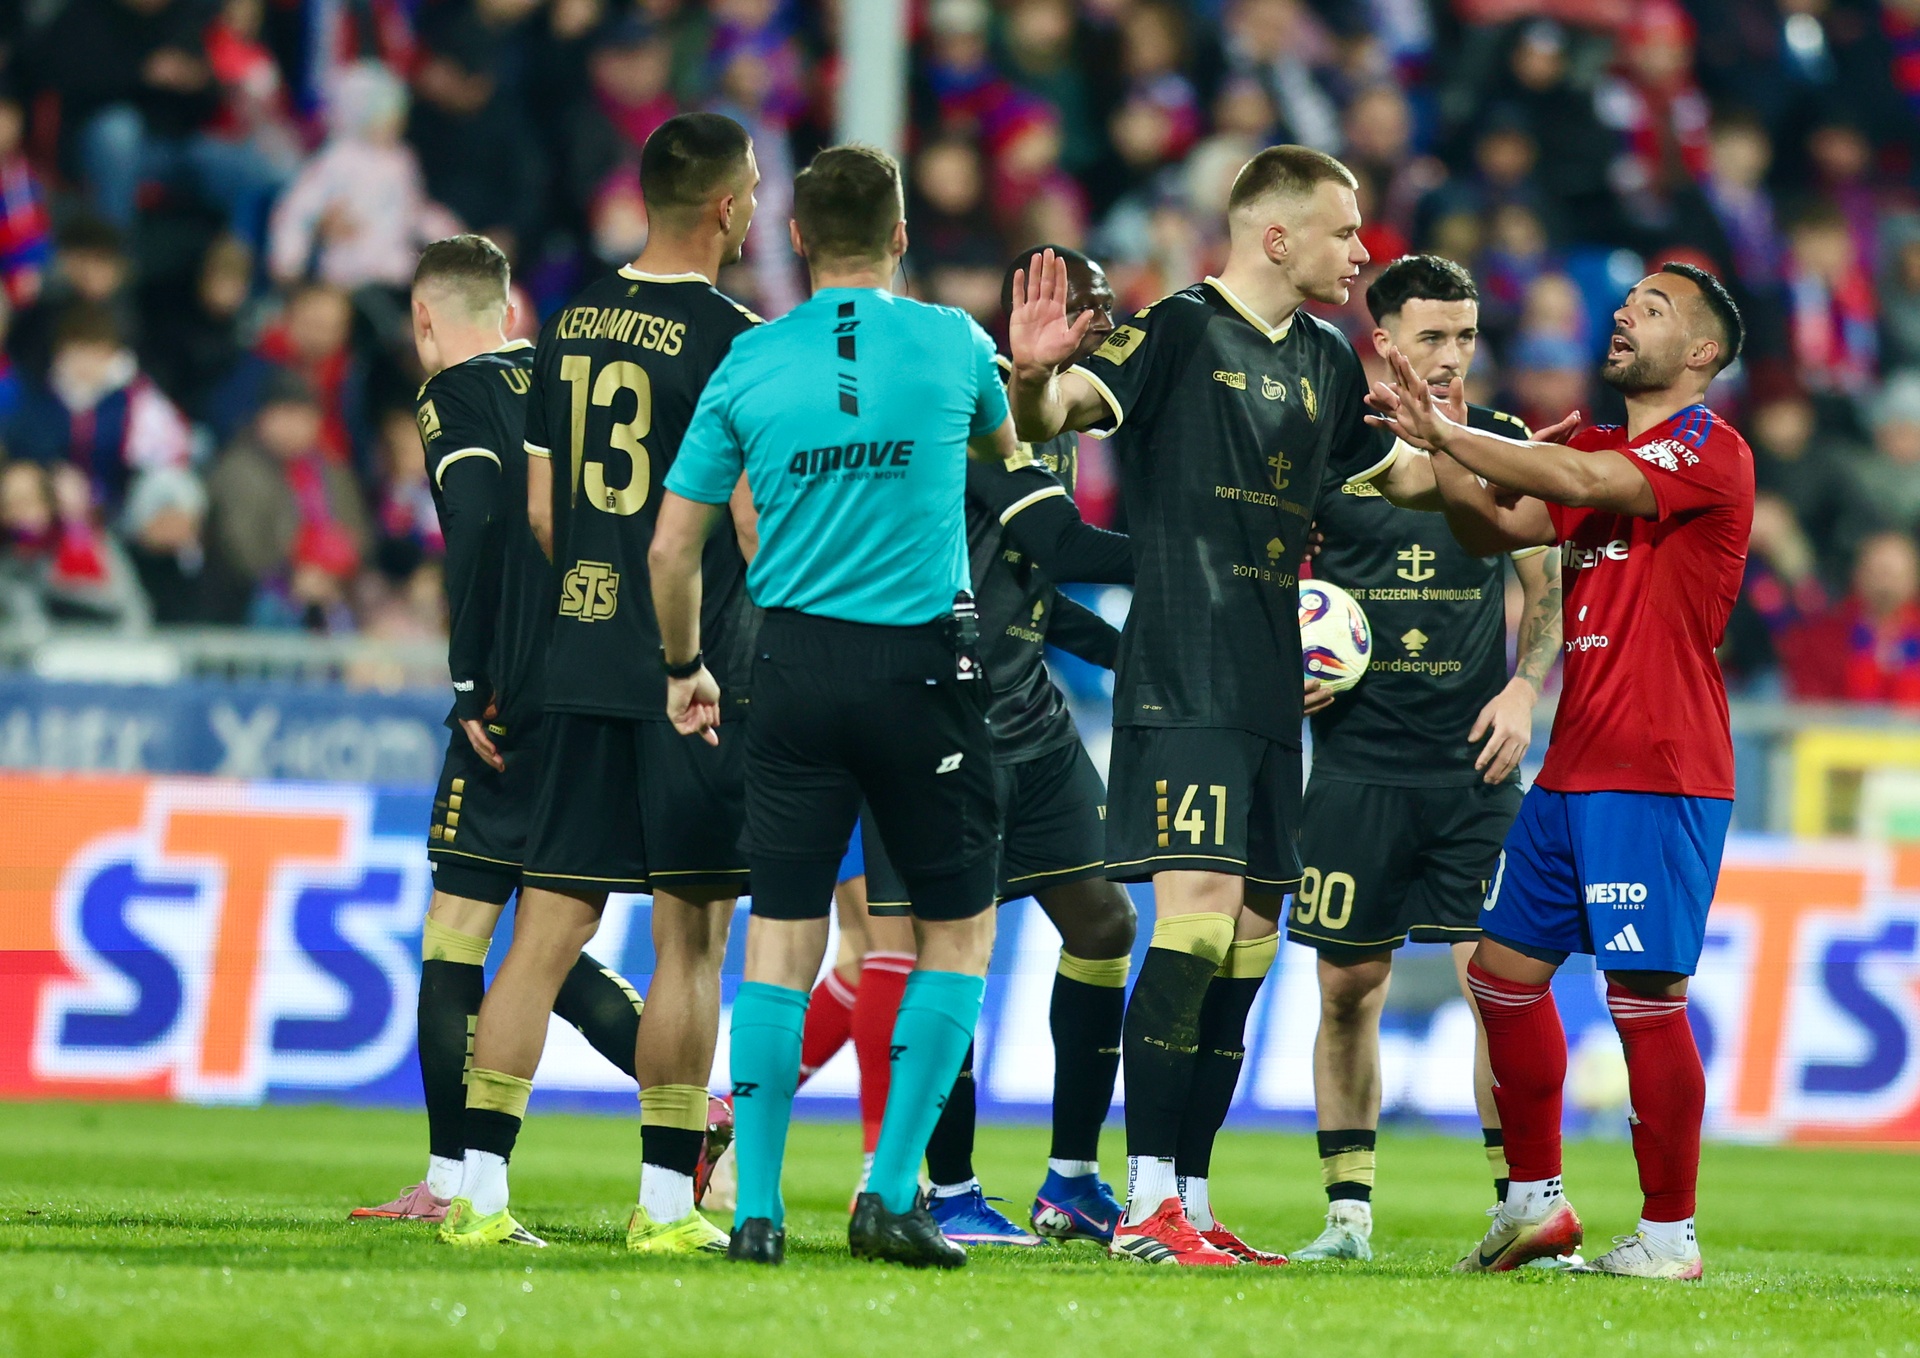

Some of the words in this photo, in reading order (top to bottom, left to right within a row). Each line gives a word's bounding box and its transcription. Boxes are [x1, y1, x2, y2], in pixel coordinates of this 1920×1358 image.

[556, 307, 686, 357] KERAMITSIS
[560, 355, 651, 516] 13
[789, 440, 915, 477] 4MOVE
[1215, 486, 1241, 500] PORT
[1342, 483, 1377, 495] cape
[559, 560, 620, 622] STS
[1369, 586, 1482, 600] SZCZECIN-ŚWINOUJŚCIE
[1369, 659, 1462, 676] ondacrypto
[1174, 784, 1226, 846] 41
[1297, 866, 1356, 930] 90
[48, 798, 416, 1090] STS
[1214, 1049, 1244, 1060] cap
